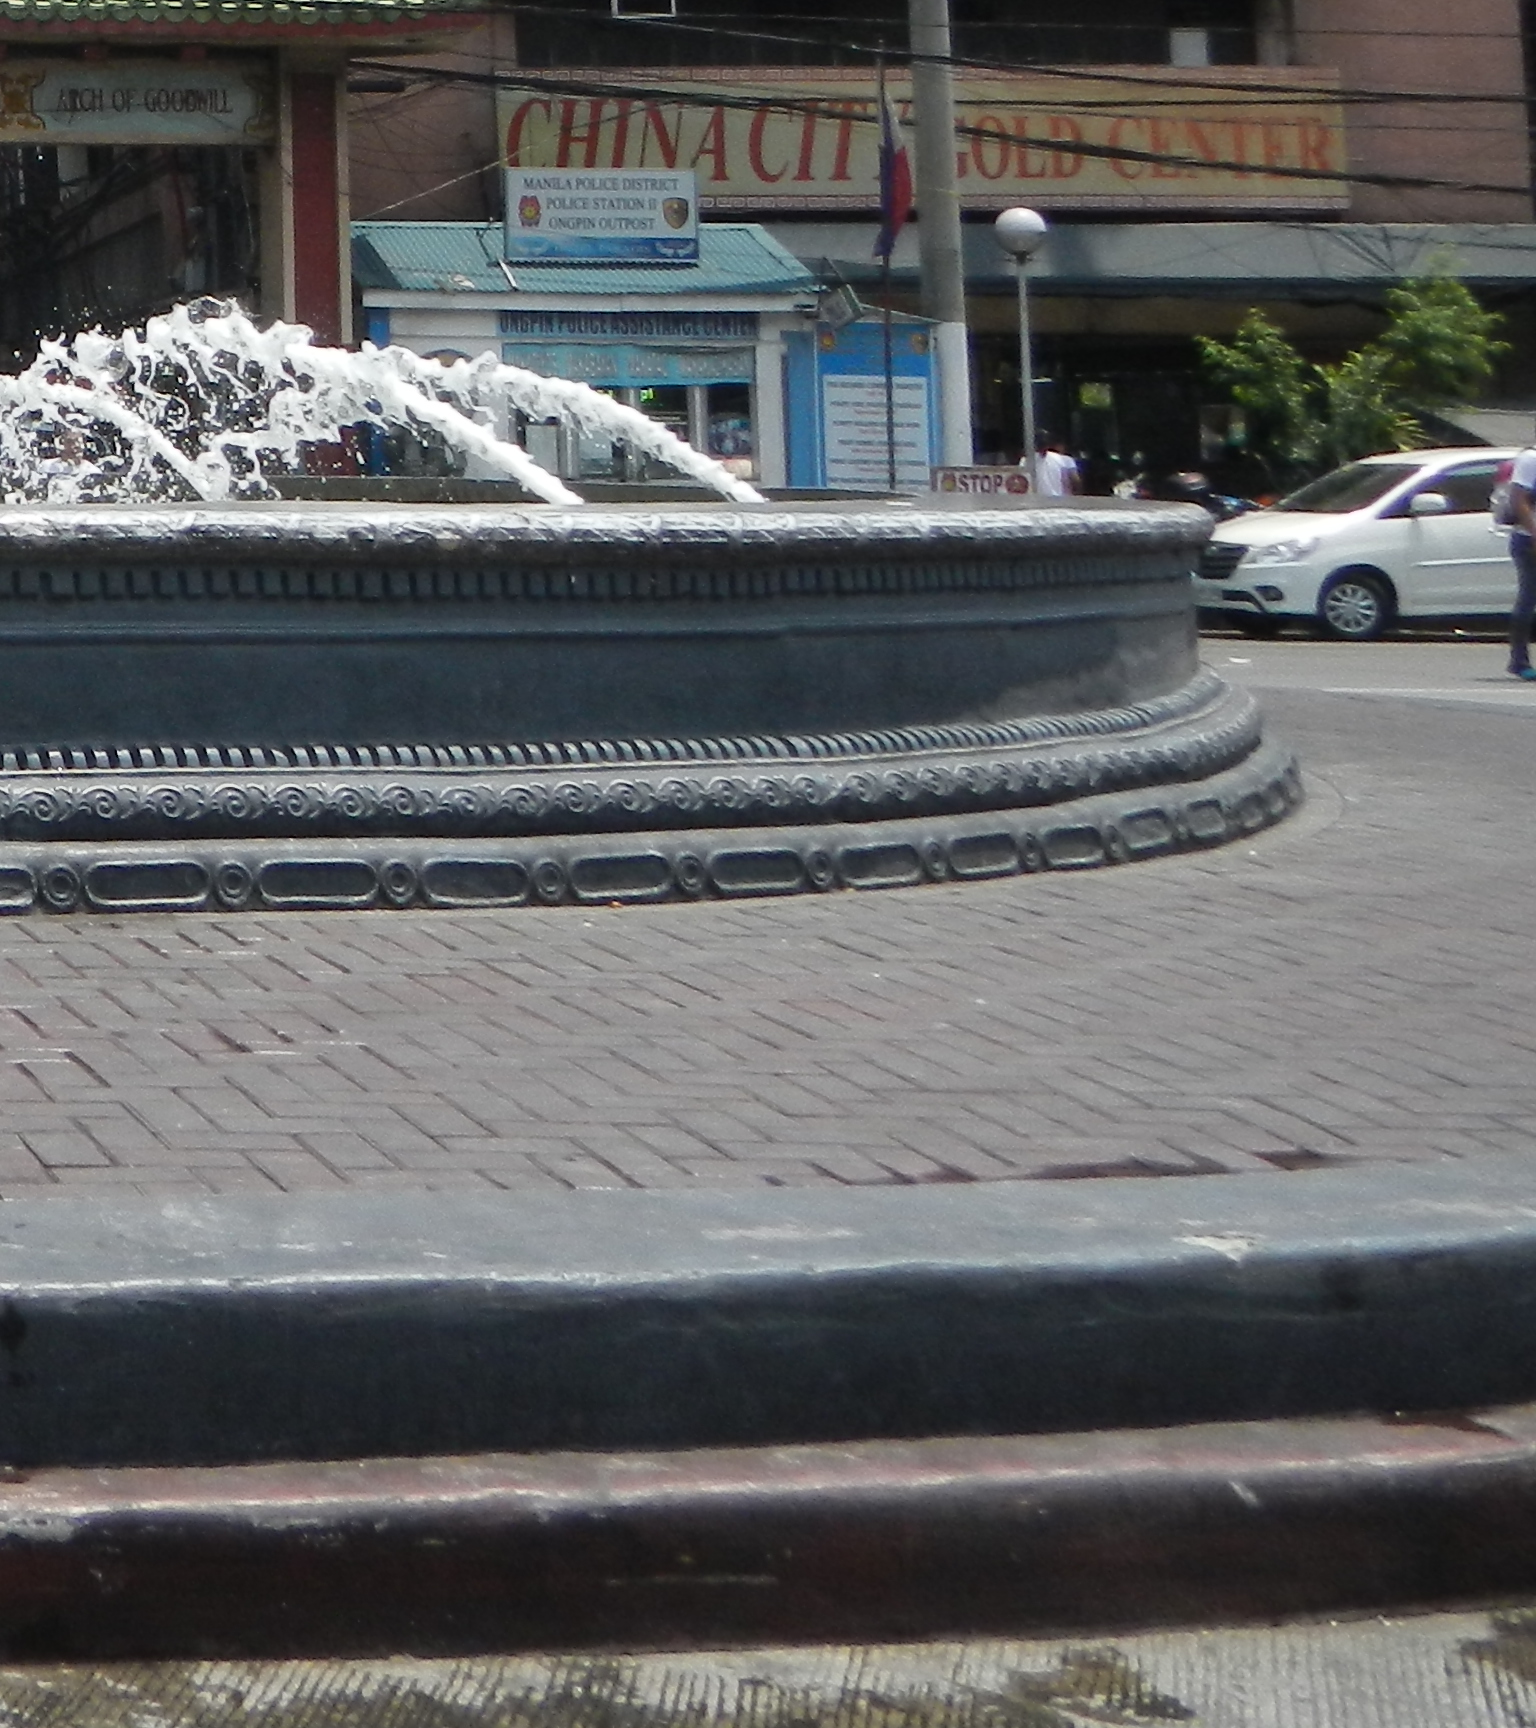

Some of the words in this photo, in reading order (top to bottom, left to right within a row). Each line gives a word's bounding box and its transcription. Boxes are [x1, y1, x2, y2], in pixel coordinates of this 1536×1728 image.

[56, 86, 104, 114] ARCH
[111, 86, 138, 113] OF
[143, 86, 234, 114] GOODWILL
[505, 98, 733, 181] CHINA
[1106, 117, 1334, 180] CENTER
[523, 177, 573, 190] MANILA
[575, 177, 620, 190] POLICE
[622, 177, 679, 191] DISTRICT
[546, 197, 589, 210] POLICE
[592, 197, 646, 210] STATION
[548, 217, 596, 230] ONGPIN
[598, 217, 656, 230] OUTPOST
[958, 474, 1003, 493] STOP
